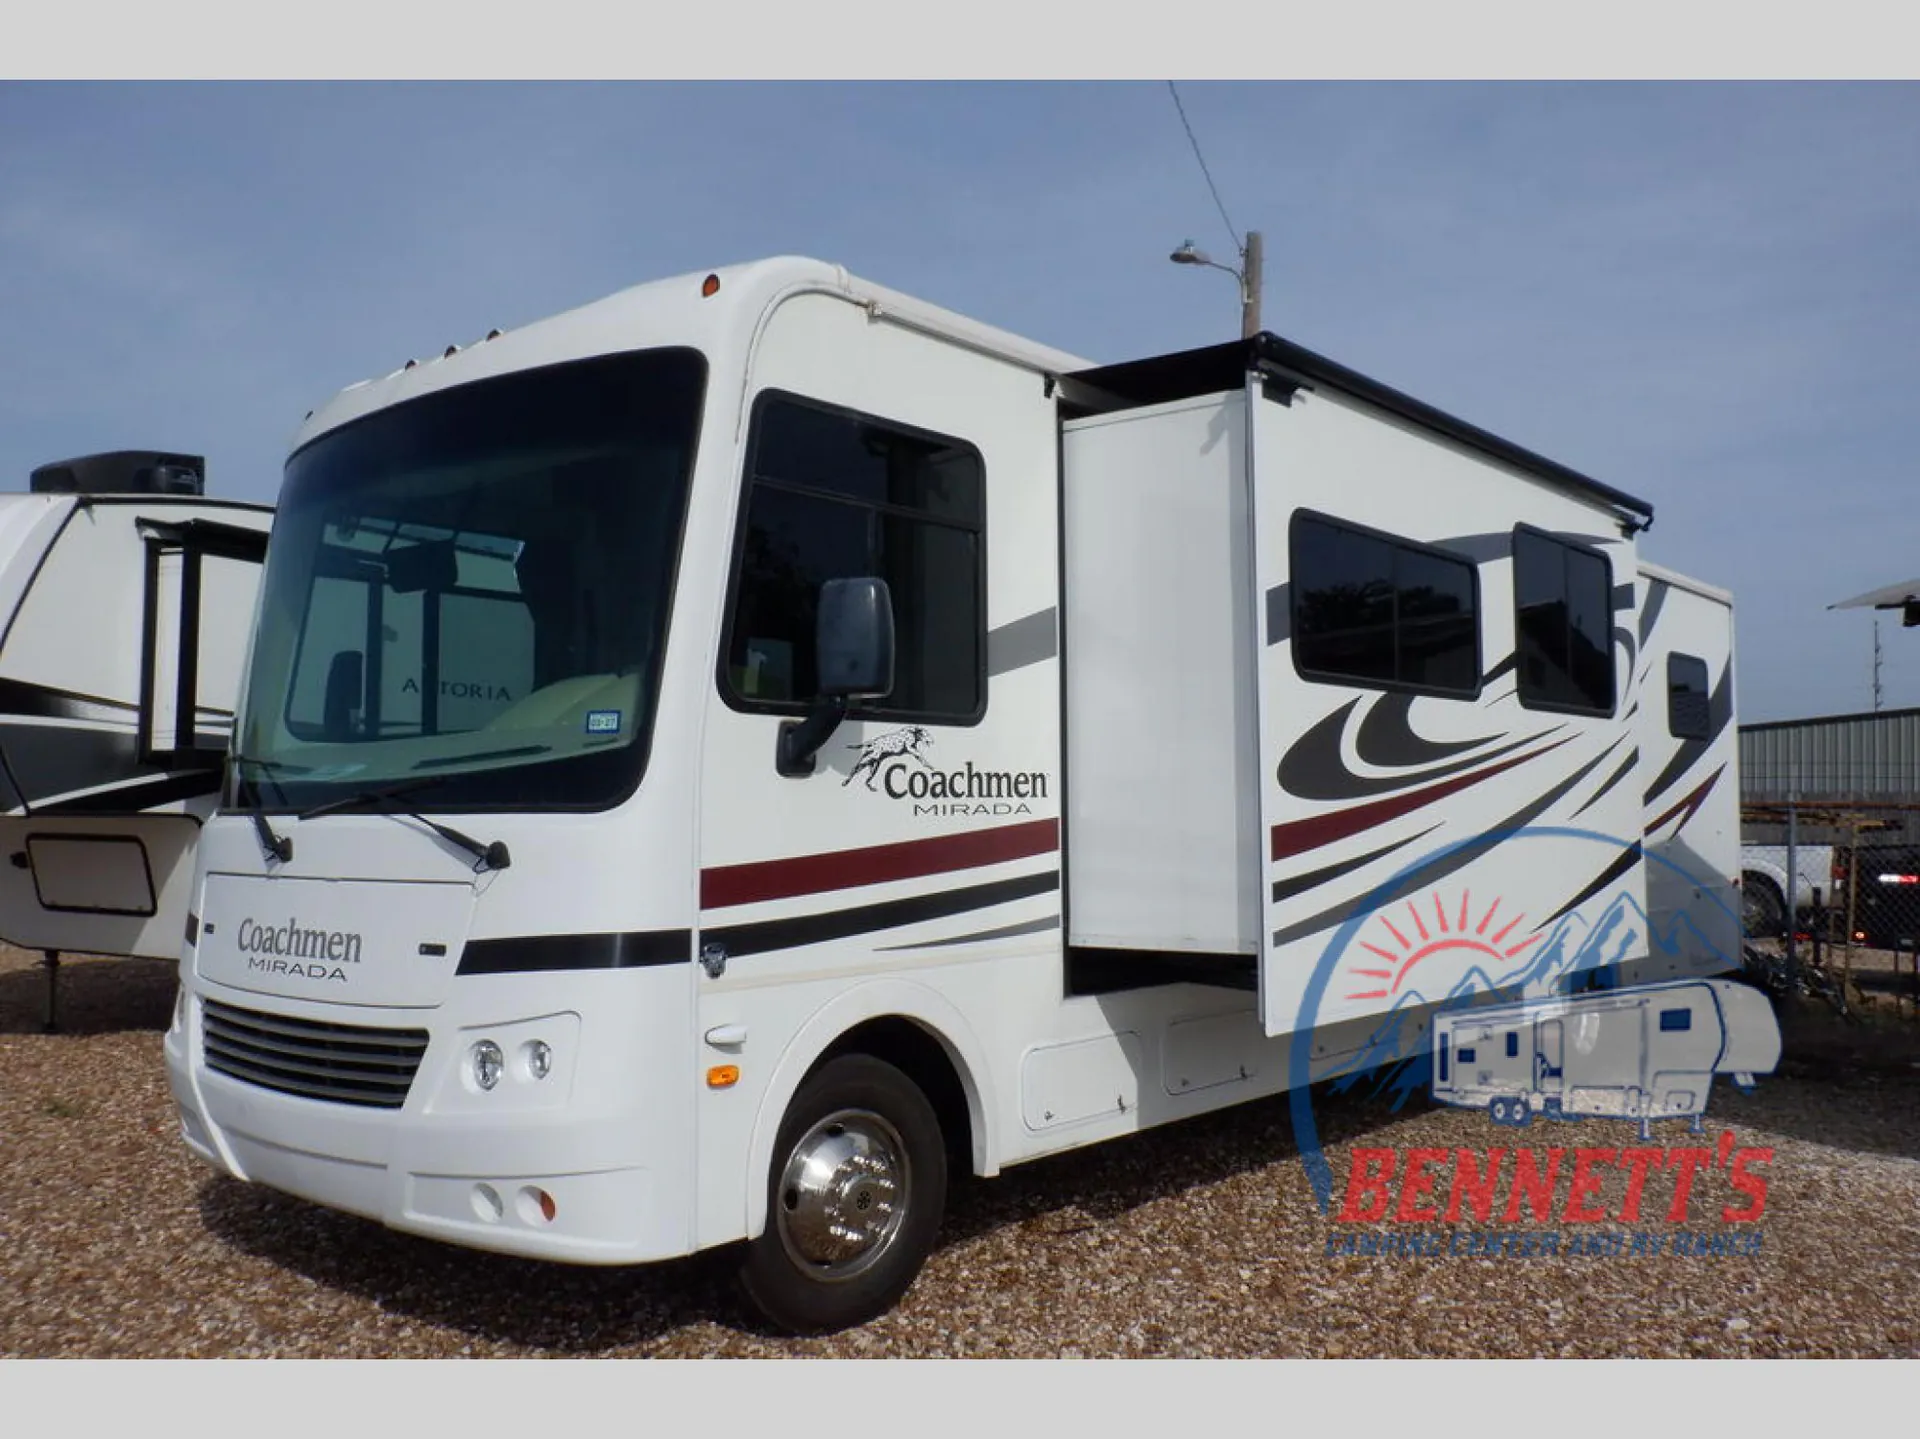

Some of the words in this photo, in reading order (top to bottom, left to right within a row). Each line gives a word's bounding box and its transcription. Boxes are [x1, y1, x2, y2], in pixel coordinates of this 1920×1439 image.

[402, 679, 512, 701] ATORIA
[884, 761, 1048, 800] Coachmen
[914, 802, 1032, 816] MIRADA
[238, 917, 362, 962] Coachmen
[248, 957, 347, 981] MIRADA
